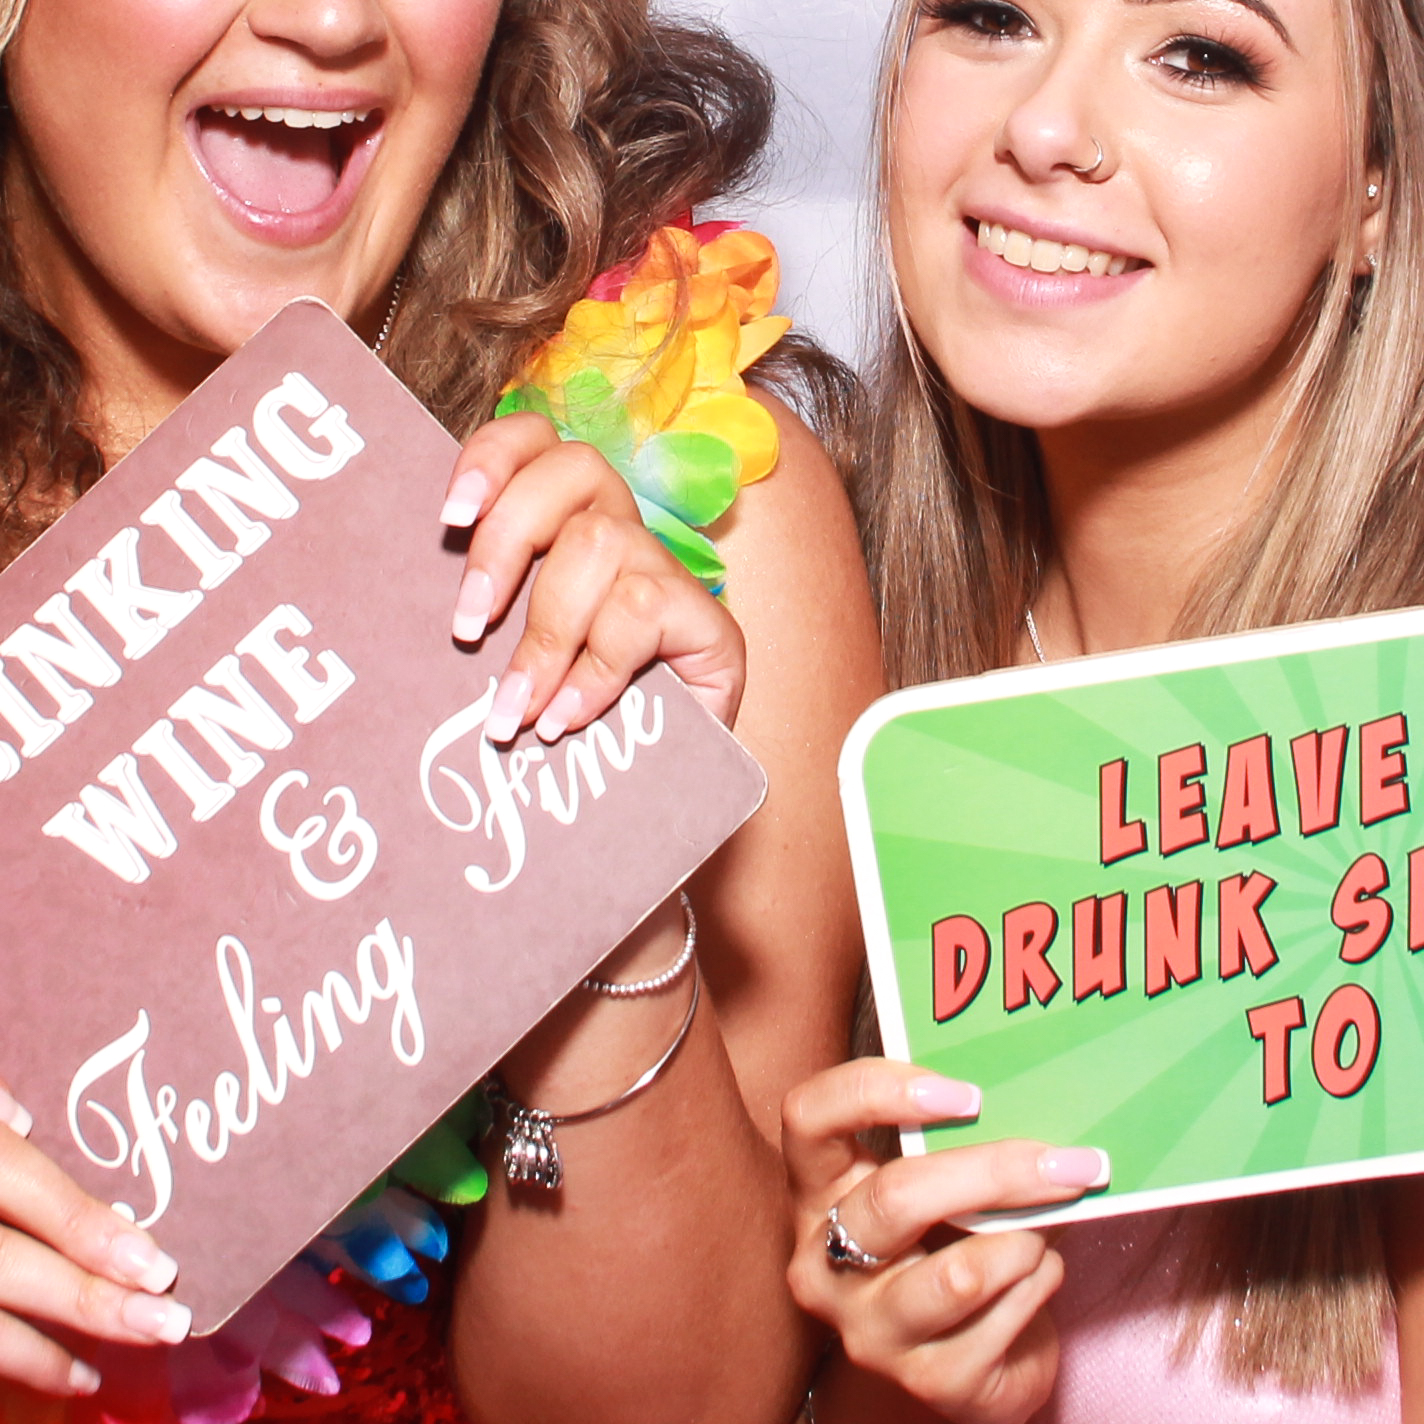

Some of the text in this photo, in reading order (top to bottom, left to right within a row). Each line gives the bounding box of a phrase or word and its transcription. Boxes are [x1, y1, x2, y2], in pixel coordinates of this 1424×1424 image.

[42, 603, 356, 885] WINE
[1099, 712, 1410, 866] LEAVE
[259, 770, 378, 901] &
[66, 676, 665, 1230] Feeling Fine
[930, 869, 1279, 1024] DRUNK
[1246, 983, 1381, 1106] TO
